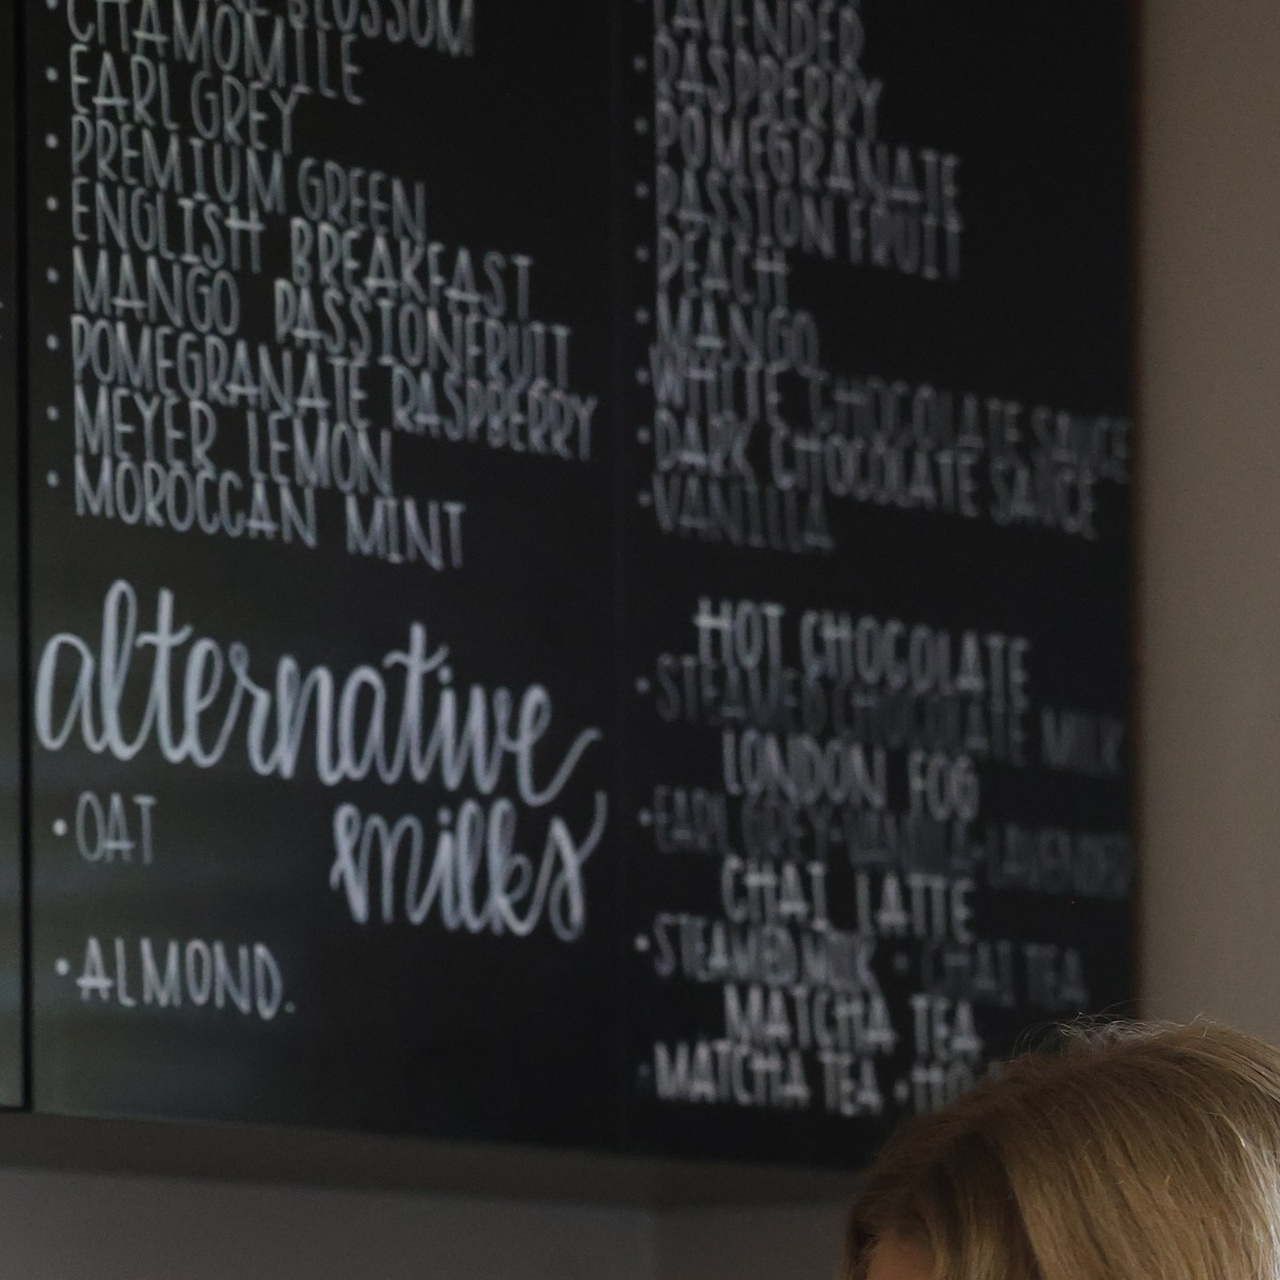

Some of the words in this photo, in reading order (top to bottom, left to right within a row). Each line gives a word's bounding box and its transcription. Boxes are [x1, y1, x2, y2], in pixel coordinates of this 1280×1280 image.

[66, 0, 366, 105] CHAMOMILE
[69, 43, 178, 132] EARL
[190, 72, 312, 154] GREY
[71, 114, 287, 215] PREMIUM
[299, 157, 428, 241] GREEN
[71, 177, 263, 273] ENGLISH
[290, 217, 533, 320] BREAKFAST
[72, 246, 240, 336] MANGO
[656, 226, 790, 312] PEACH
[71, 314, 371, 429] POMEGRANATE
[391, 364, 598, 461] RASPBERRY
[73, 384, 219, 472] MEYER
[246, 405, 393, 498] LEMON
[74, 453, 317, 550] MOROCCAN
[345, 492, 465, 570] MINT
[34, 578, 602, 808] alternative
[694, 596, 785, 678] HOT
[800, 608, 1032, 706] CHOCOLATE
[75, 792, 157, 864] OAT
[721, 727, 888, 810] LONDON
[905, 750, 980, 824] FOG
[329, 790, 608, 942] milks
[721, 852, 827, 932] CHAI
[854, 868, 976, 946] LATTE
[722, 982, 898, 1058] MATCHA
[910, 992, 985, 1058] TEA
[653, 1040, 810, 1110] MATCHA
[818, 1050, 886, 1118] TEA
